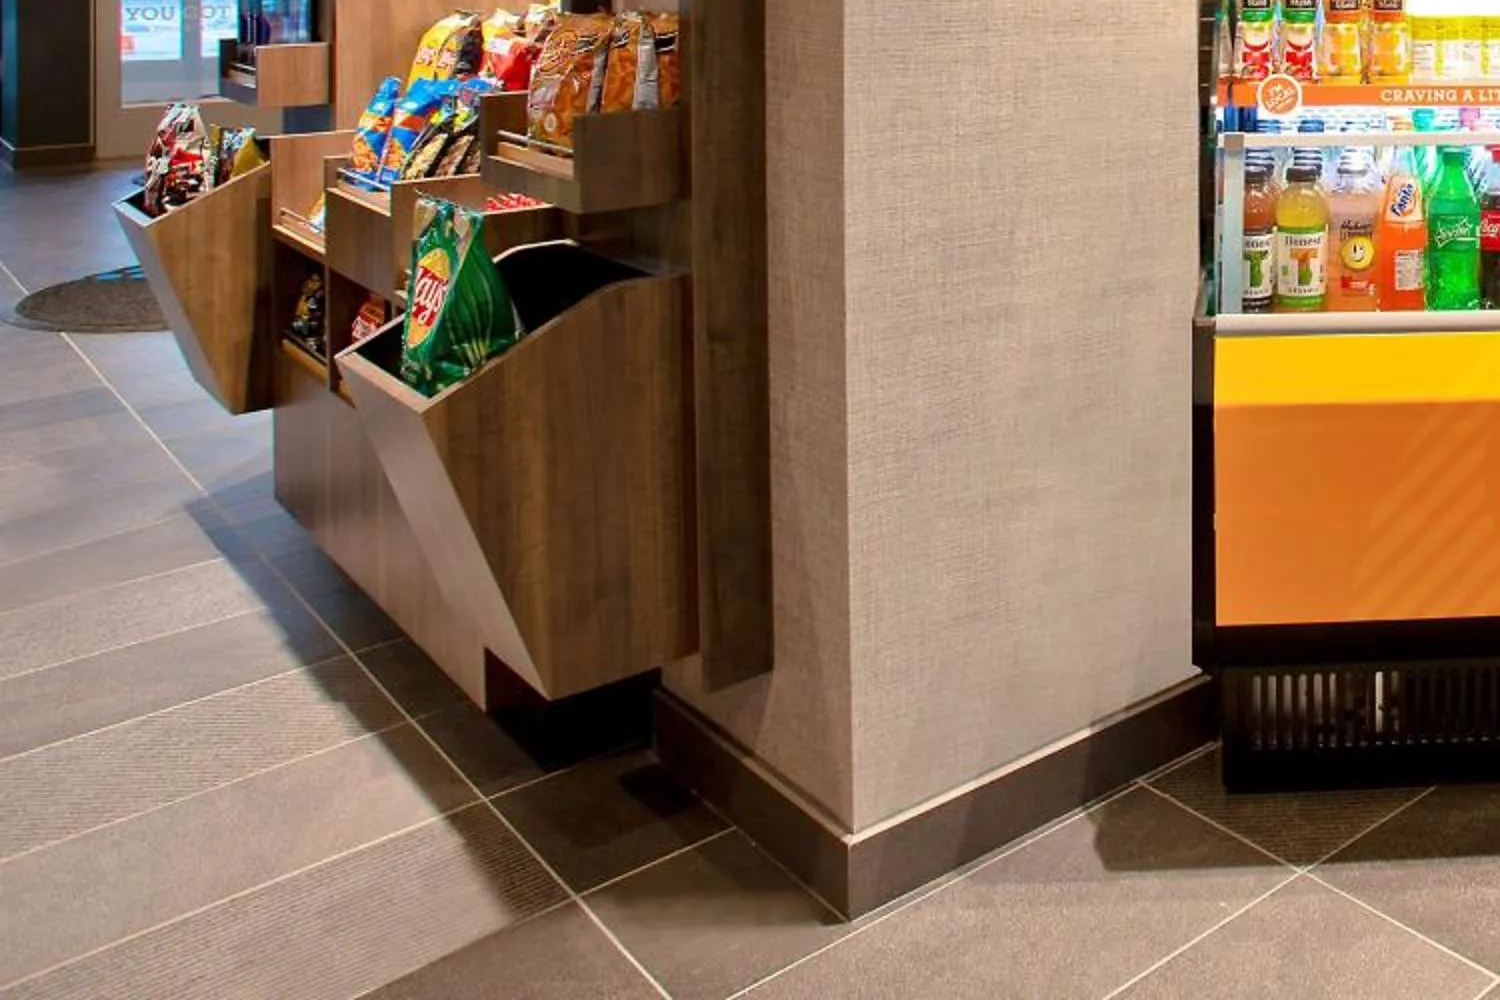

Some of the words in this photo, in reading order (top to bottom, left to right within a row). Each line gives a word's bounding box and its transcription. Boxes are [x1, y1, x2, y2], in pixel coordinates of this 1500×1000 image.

[126, 6, 175, 21] YOU
[1381, 88, 1457, 102] CRAVING
[1463, 88, 1475, 101] A
[1284, 236, 1321, 246] Honest
